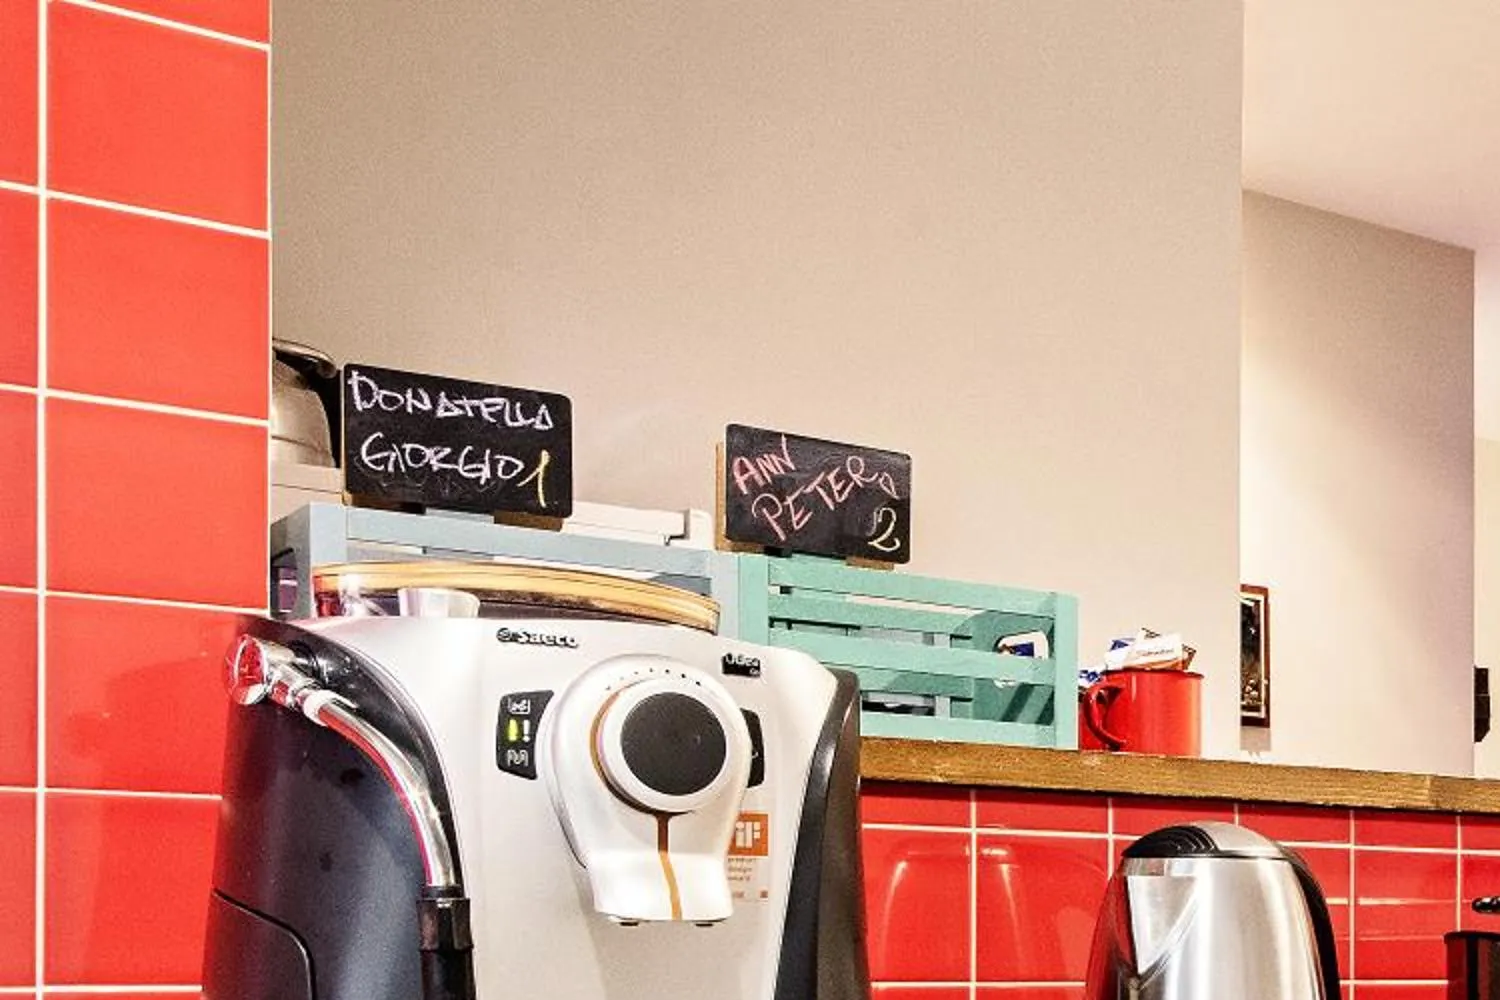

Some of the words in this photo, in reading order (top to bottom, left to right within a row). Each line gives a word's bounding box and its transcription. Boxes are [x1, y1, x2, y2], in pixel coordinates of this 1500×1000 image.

[361, 432, 525, 485] GIORGIO
[733, 433, 796, 494] ANN
[868, 507, 901, 552] 2
